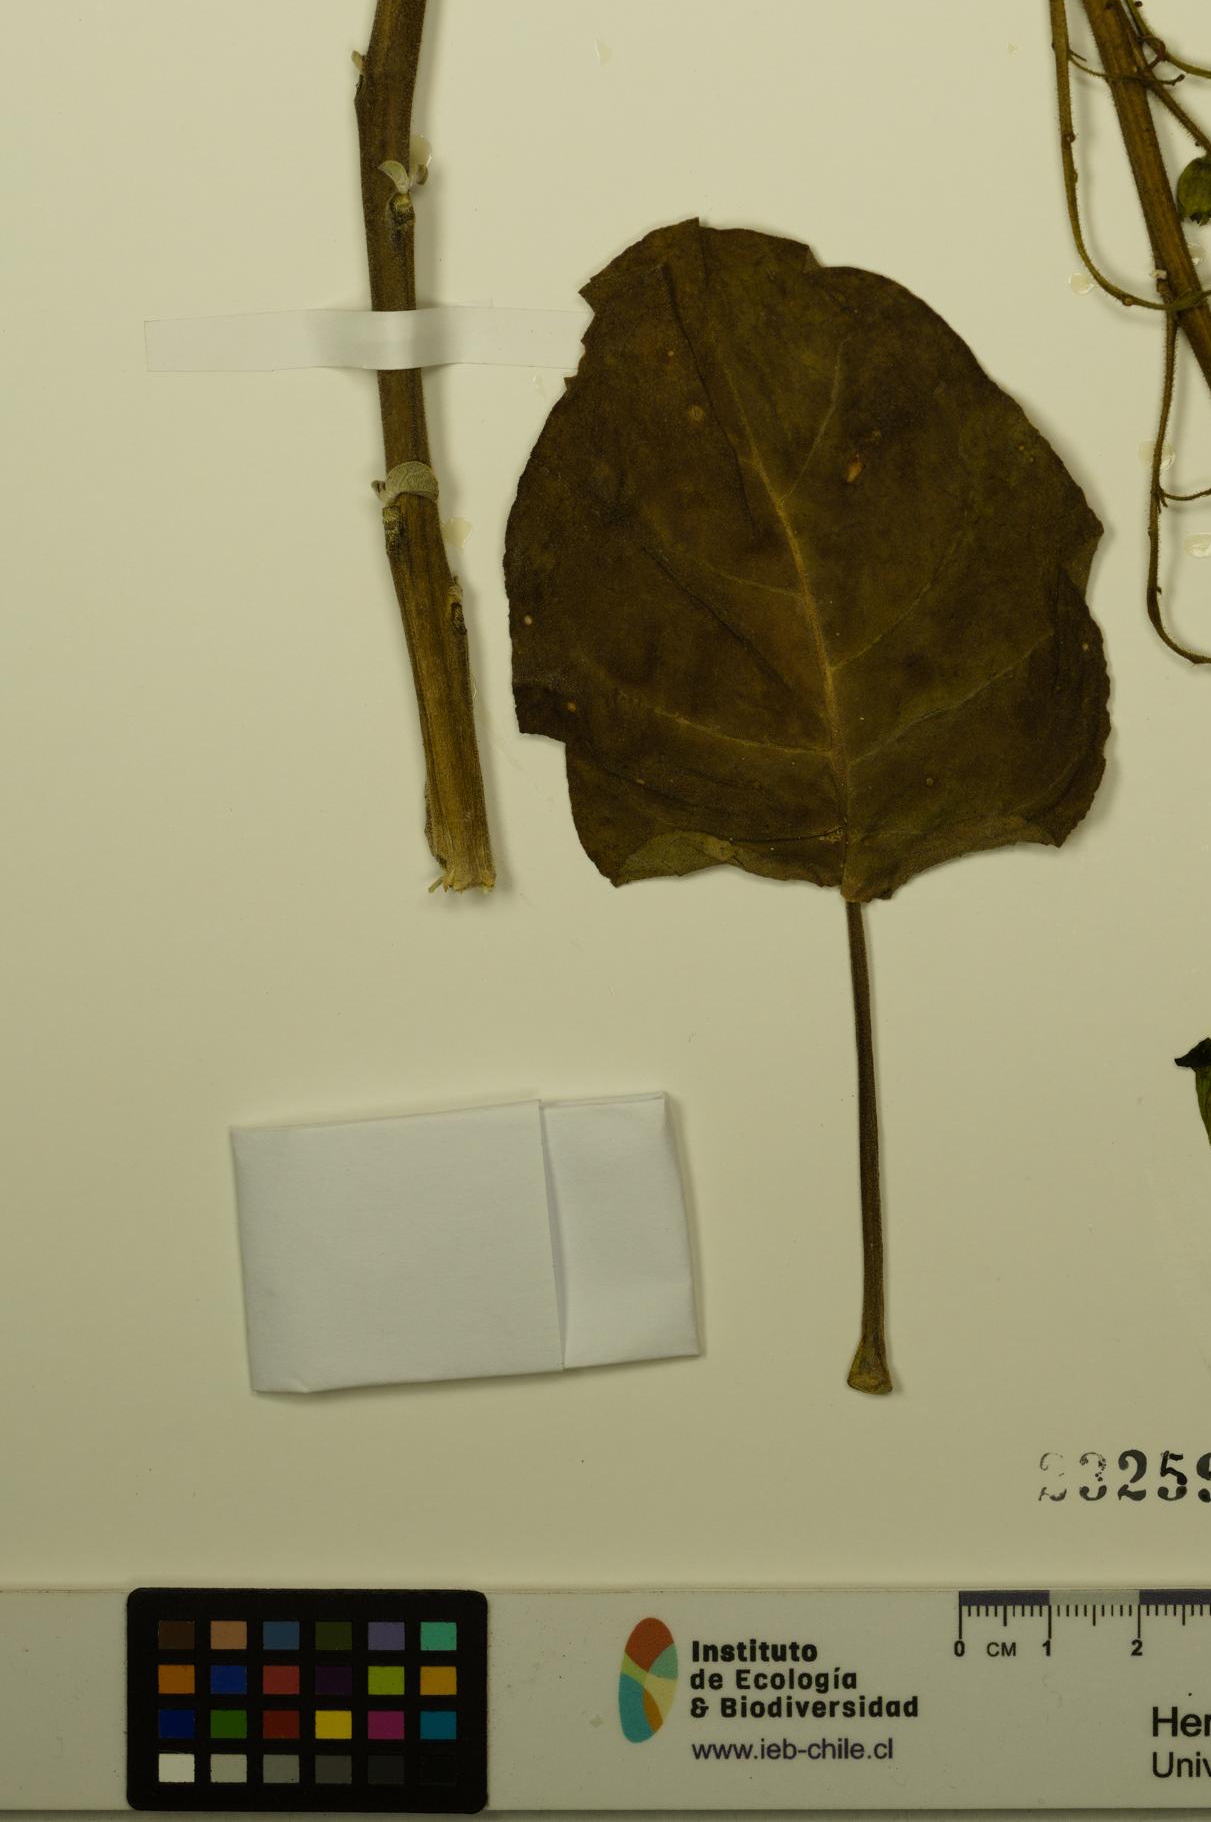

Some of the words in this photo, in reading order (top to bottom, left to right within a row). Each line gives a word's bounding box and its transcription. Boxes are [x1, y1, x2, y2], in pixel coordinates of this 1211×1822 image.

[692, 1638, 818, 1663] Instituto
[953, 1641, 966, 1658] 0
[986, 1641, 1017, 1658] CM
[1041, 1641, 1051, 1657] 1
[1130, 1640, 1143, 1657] 2
[689, 1668, 724, 1691] de
[735, 1666, 858, 1694] Ecología
[690, 1696, 710, 1719] &
[720, 1693, 919, 1719] Biodiversidad
[691, 1736, 894, 1762] www.ieb-chile.cl
